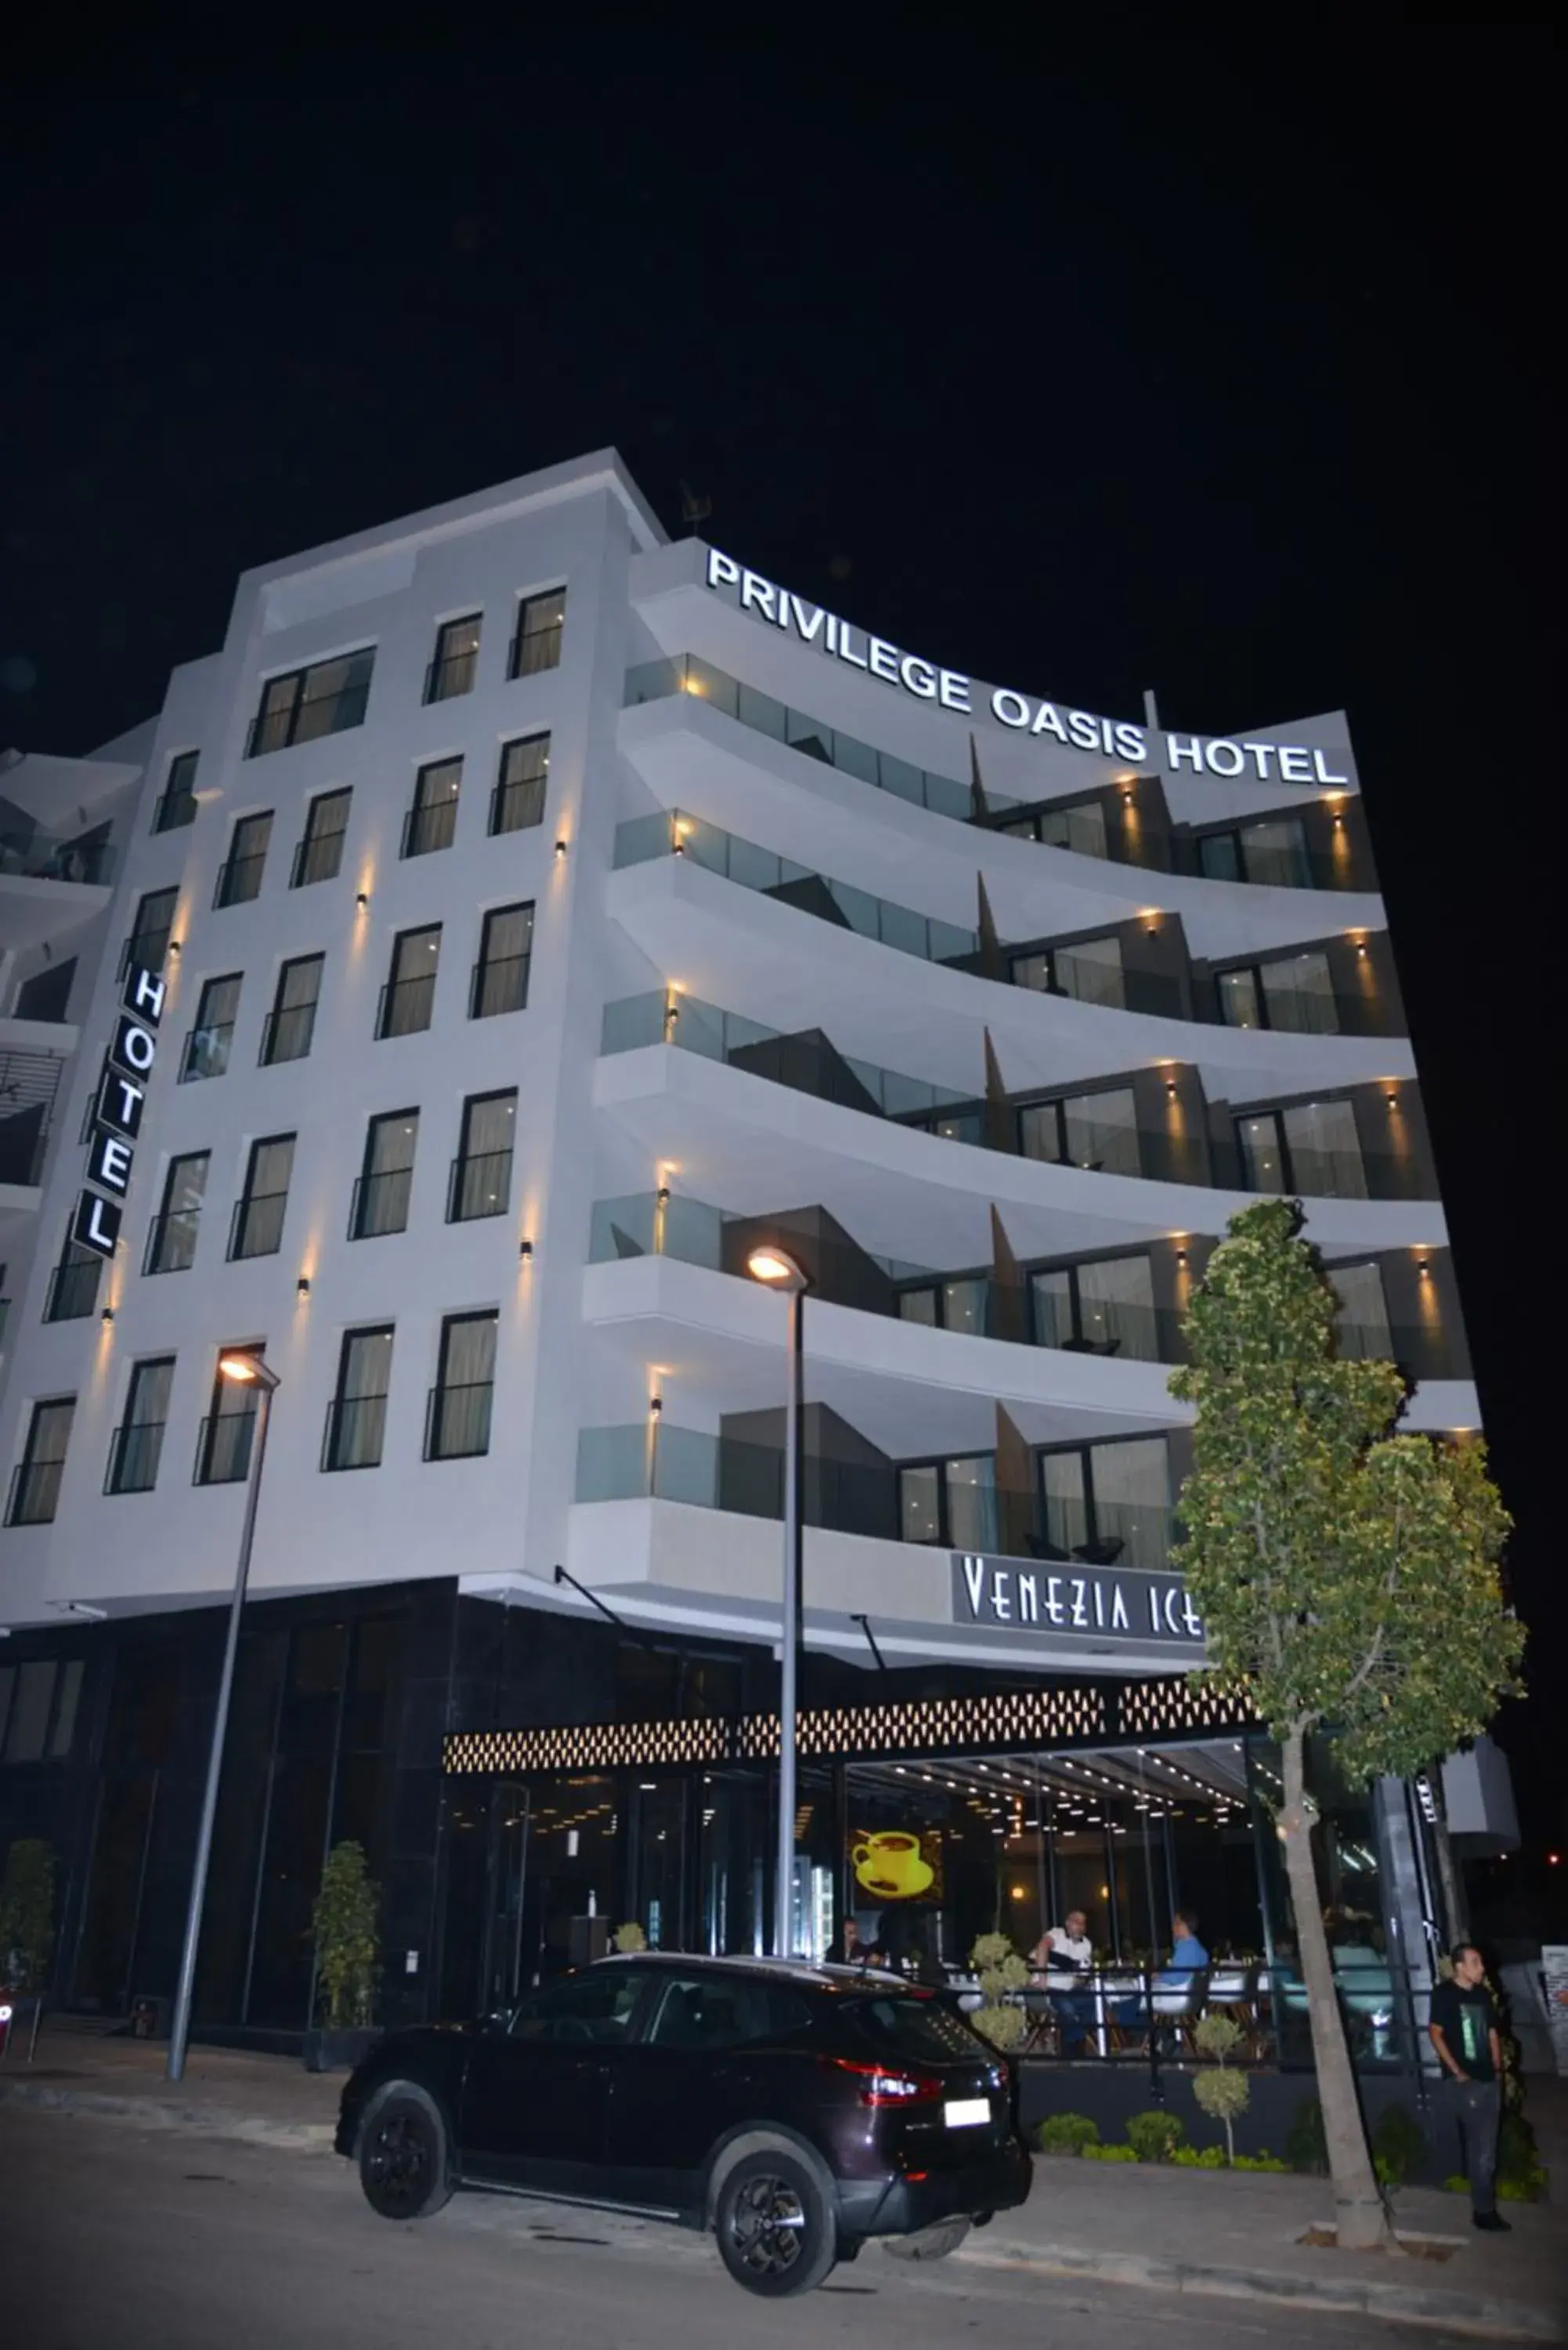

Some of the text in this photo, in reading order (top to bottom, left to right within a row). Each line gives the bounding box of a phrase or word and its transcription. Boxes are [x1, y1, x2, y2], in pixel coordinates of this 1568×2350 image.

[706, 548, 1349, 785] PRIVILEGE OASIS HOTEL
[89, 969, 165, 1249] HOTEL
[963, 1556, 1202, 1636] VENEZIA ICE
